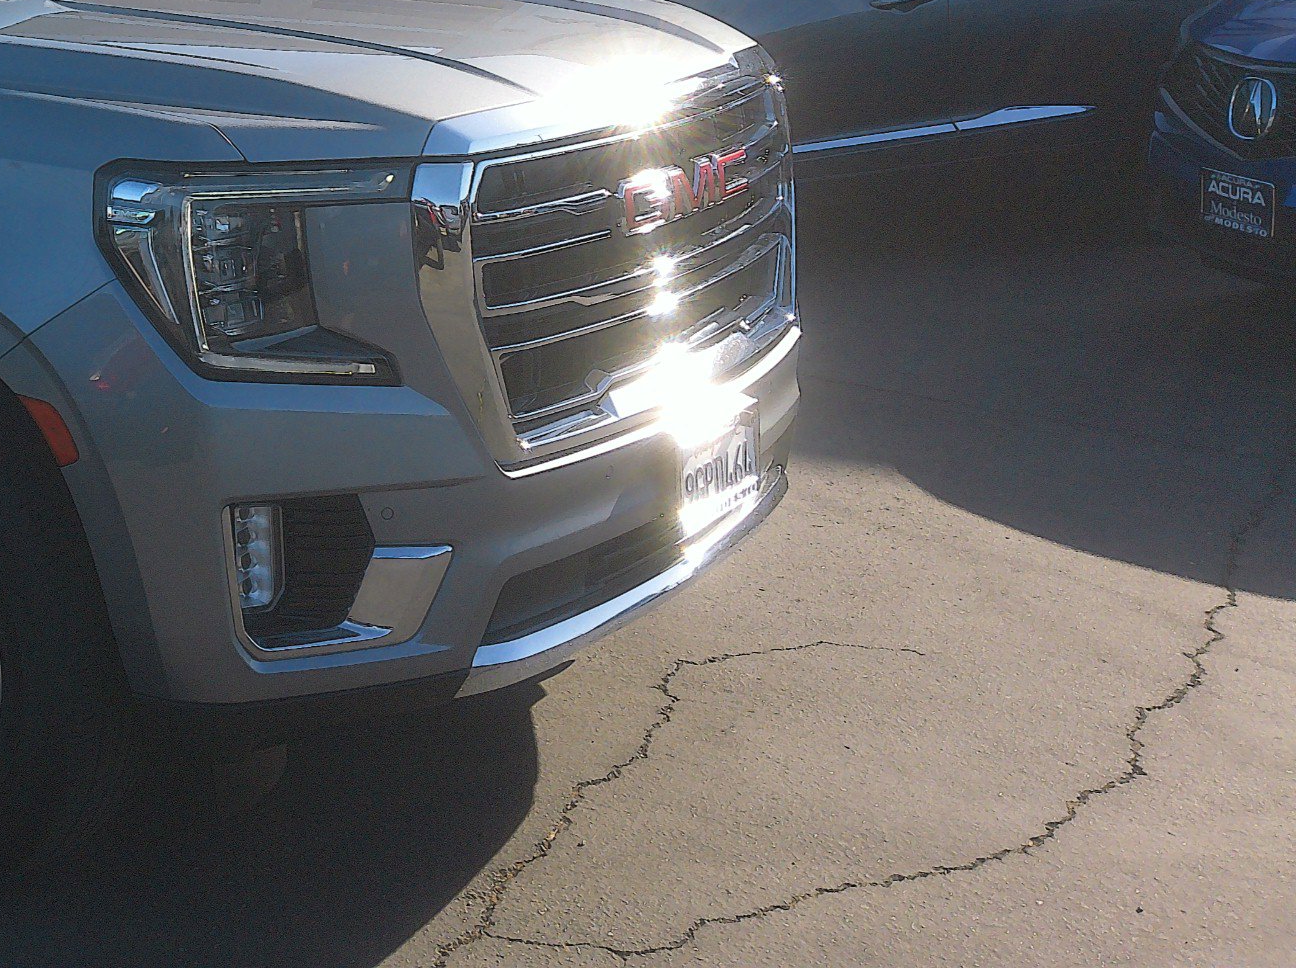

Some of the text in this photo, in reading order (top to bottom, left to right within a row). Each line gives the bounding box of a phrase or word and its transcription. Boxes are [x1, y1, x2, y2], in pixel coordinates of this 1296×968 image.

[618, 147, 750, 235] GMC
[1208, 179, 1266, 207] ACURA
[1210, 200, 1262, 226] Modesto
[1214, 216, 1268, 238] MODESTO
